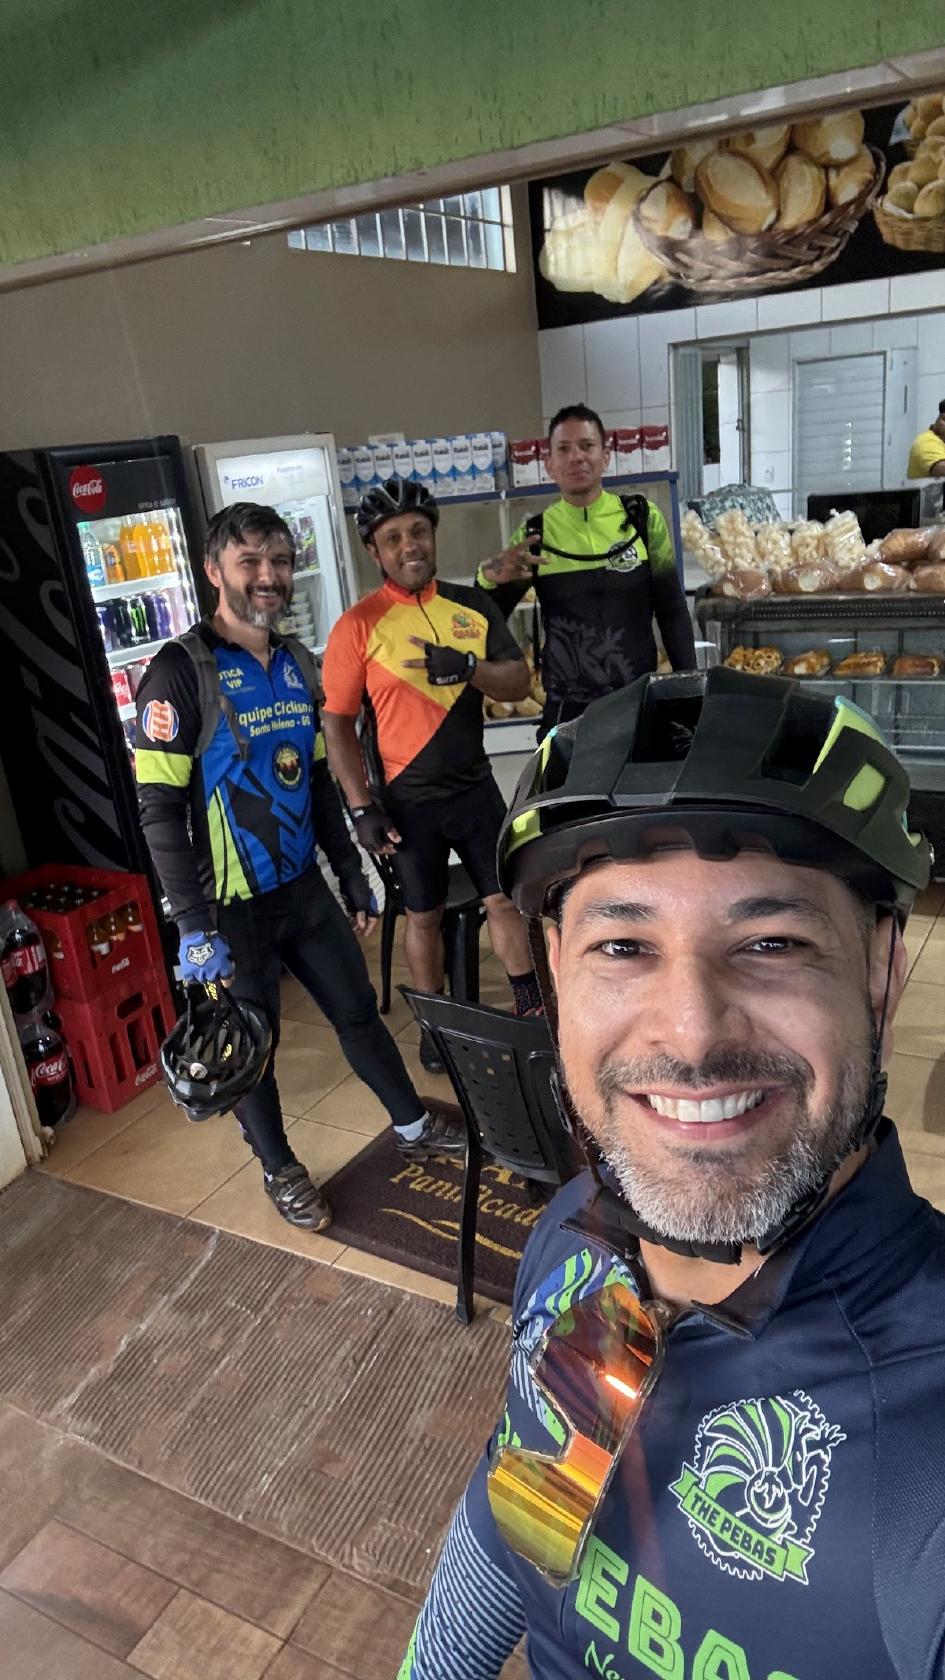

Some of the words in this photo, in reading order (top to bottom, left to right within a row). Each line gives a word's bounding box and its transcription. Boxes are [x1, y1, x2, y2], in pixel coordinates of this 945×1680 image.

[231, 475, 264, 491] FRICON
[226, 679, 243, 689] VIP
[235, 706, 273, 727] quipe
[690, 1492, 720, 1529] THE
[719, 1517, 777, 1567] PEBAS
